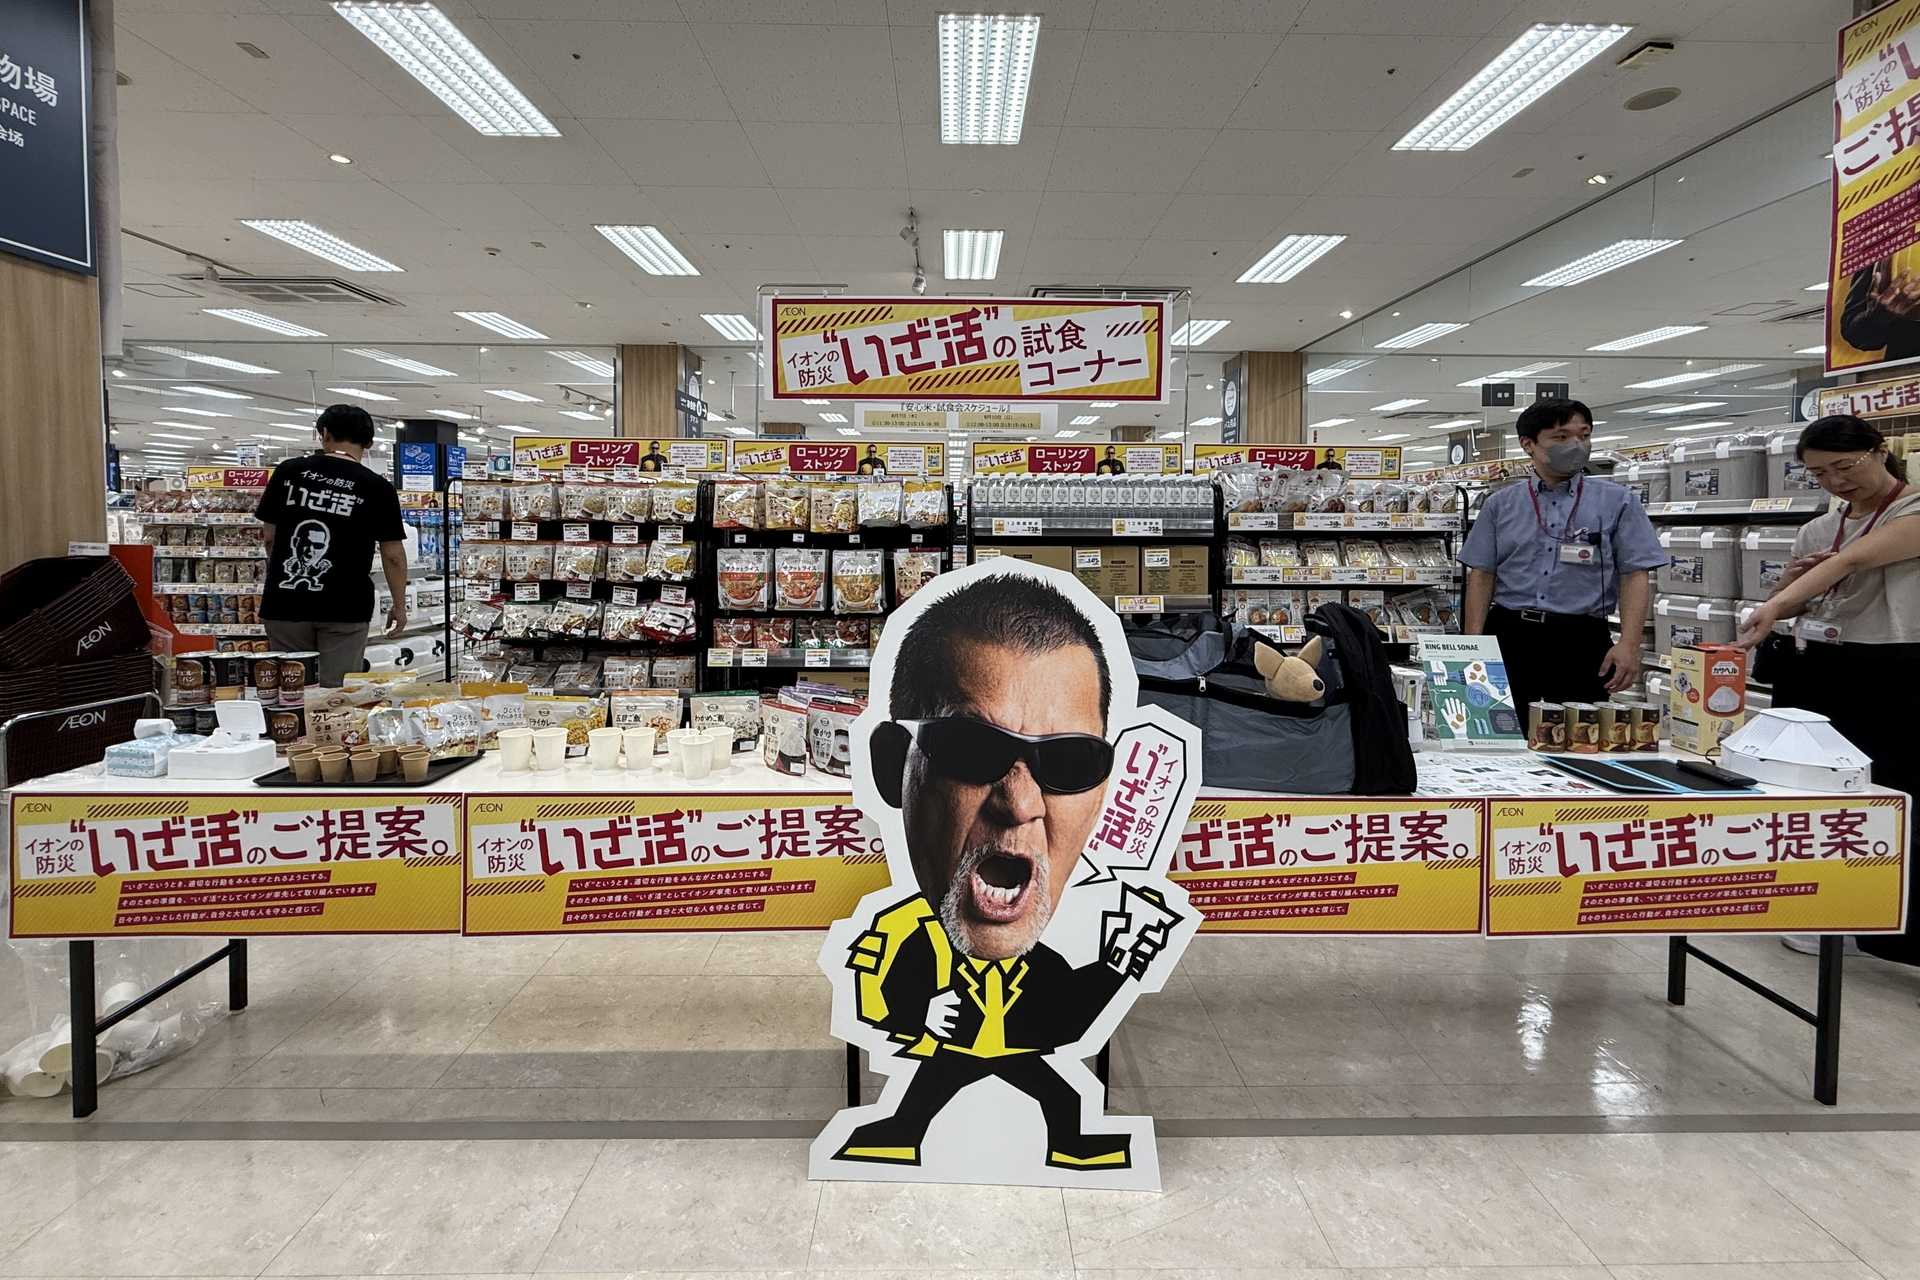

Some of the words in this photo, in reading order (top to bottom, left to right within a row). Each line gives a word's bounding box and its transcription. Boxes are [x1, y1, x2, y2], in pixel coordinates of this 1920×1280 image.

[1843, 60, 1897, 100] イオンの
[1855, 77, 1893, 113] 防災
[786, 349, 840, 370] イオンの
[1027, 349, 1142, 387] コーナー
[799, 369, 835, 388] 防災
[578, 443, 633, 453] ローリング
[796, 447, 850, 457] ローリング
[1035, 448, 1089, 459] ローリング
[1256, 451, 1309, 460] ローリング
[585, 456, 626, 466] ストック
[803, 459, 843, 470] ストック
[1042, 461, 1082, 471] ストック
[301, 470, 355, 490] イオンの防災
[284, 480, 365, 517] “いざ活”
[616, 714, 641, 722] 五目ご飯
[1126, 759, 1179, 860] イオンの防災
[25, 838, 84, 855] イオンの
[477, 838, 533, 854] イオンの
[1169, 811, 1469, 872] ざ活”のご提案。
[1499, 841, 1551, 857] イオンの
[36, 854, 76, 875] 防災
[488, 853, 526, 874] 防災
[1509, 856, 1544, 875] 防災
